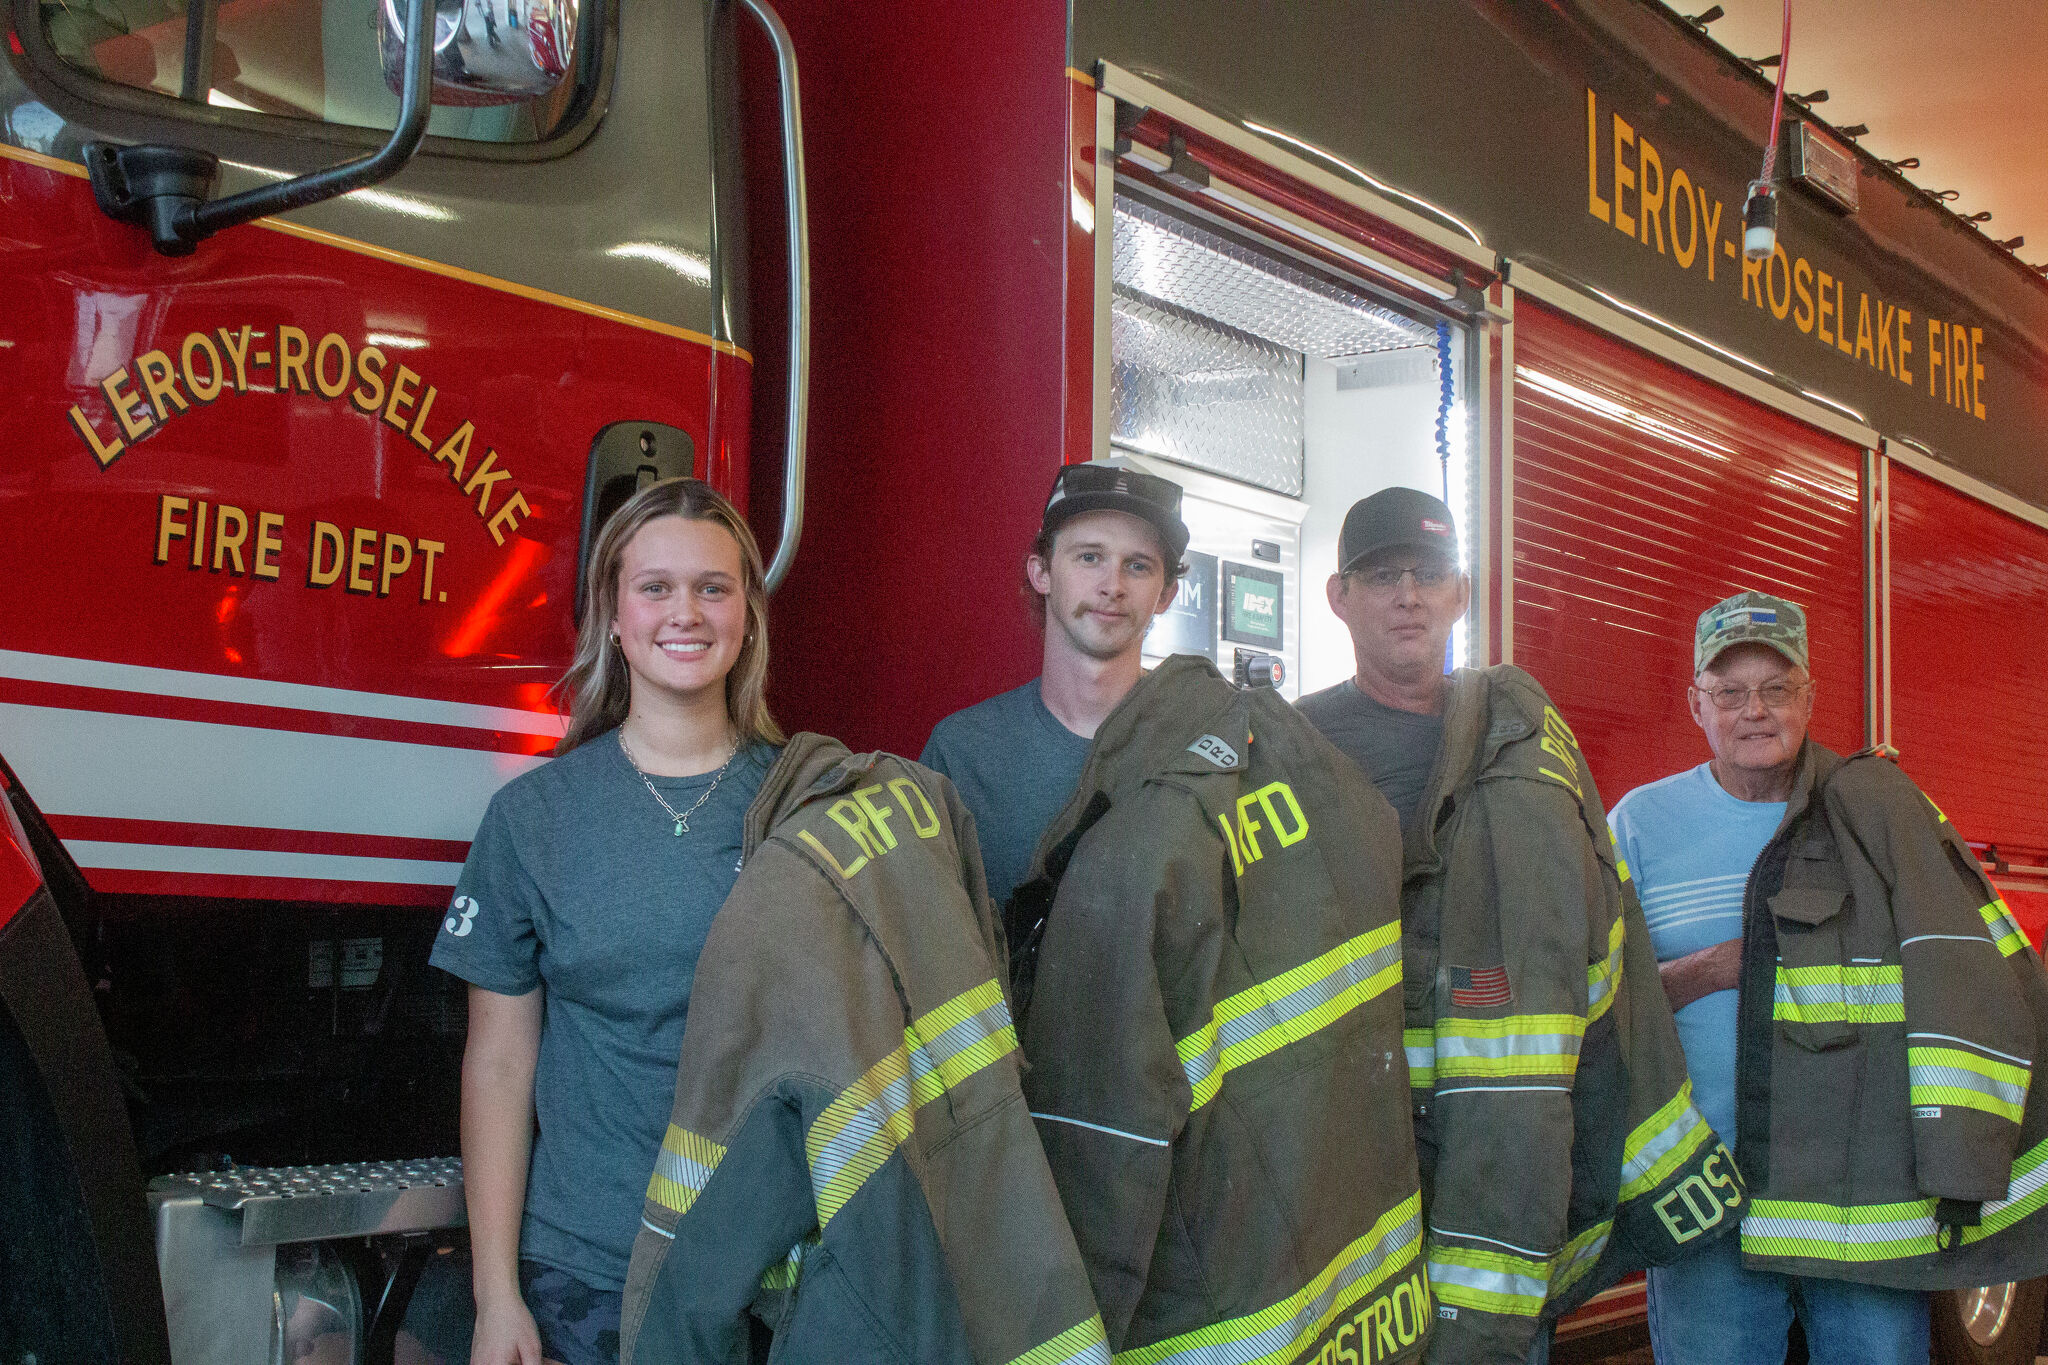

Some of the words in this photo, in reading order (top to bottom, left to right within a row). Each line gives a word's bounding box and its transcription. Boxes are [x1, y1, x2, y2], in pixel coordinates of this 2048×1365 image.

[1587, 87, 1912, 386] LEROY-ROSELAKE
[1928, 318, 1986, 421] FIRE
[67, 324, 532, 547] LEROY-ROSELAKE
[154, 495, 285, 581] FIRE
[308, 520, 448, 602] DEPT.
[1198, 738, 1235, 767] DRD
[796, 777, 941, 880] LRFD
[445, 895, 480, 937] 3
